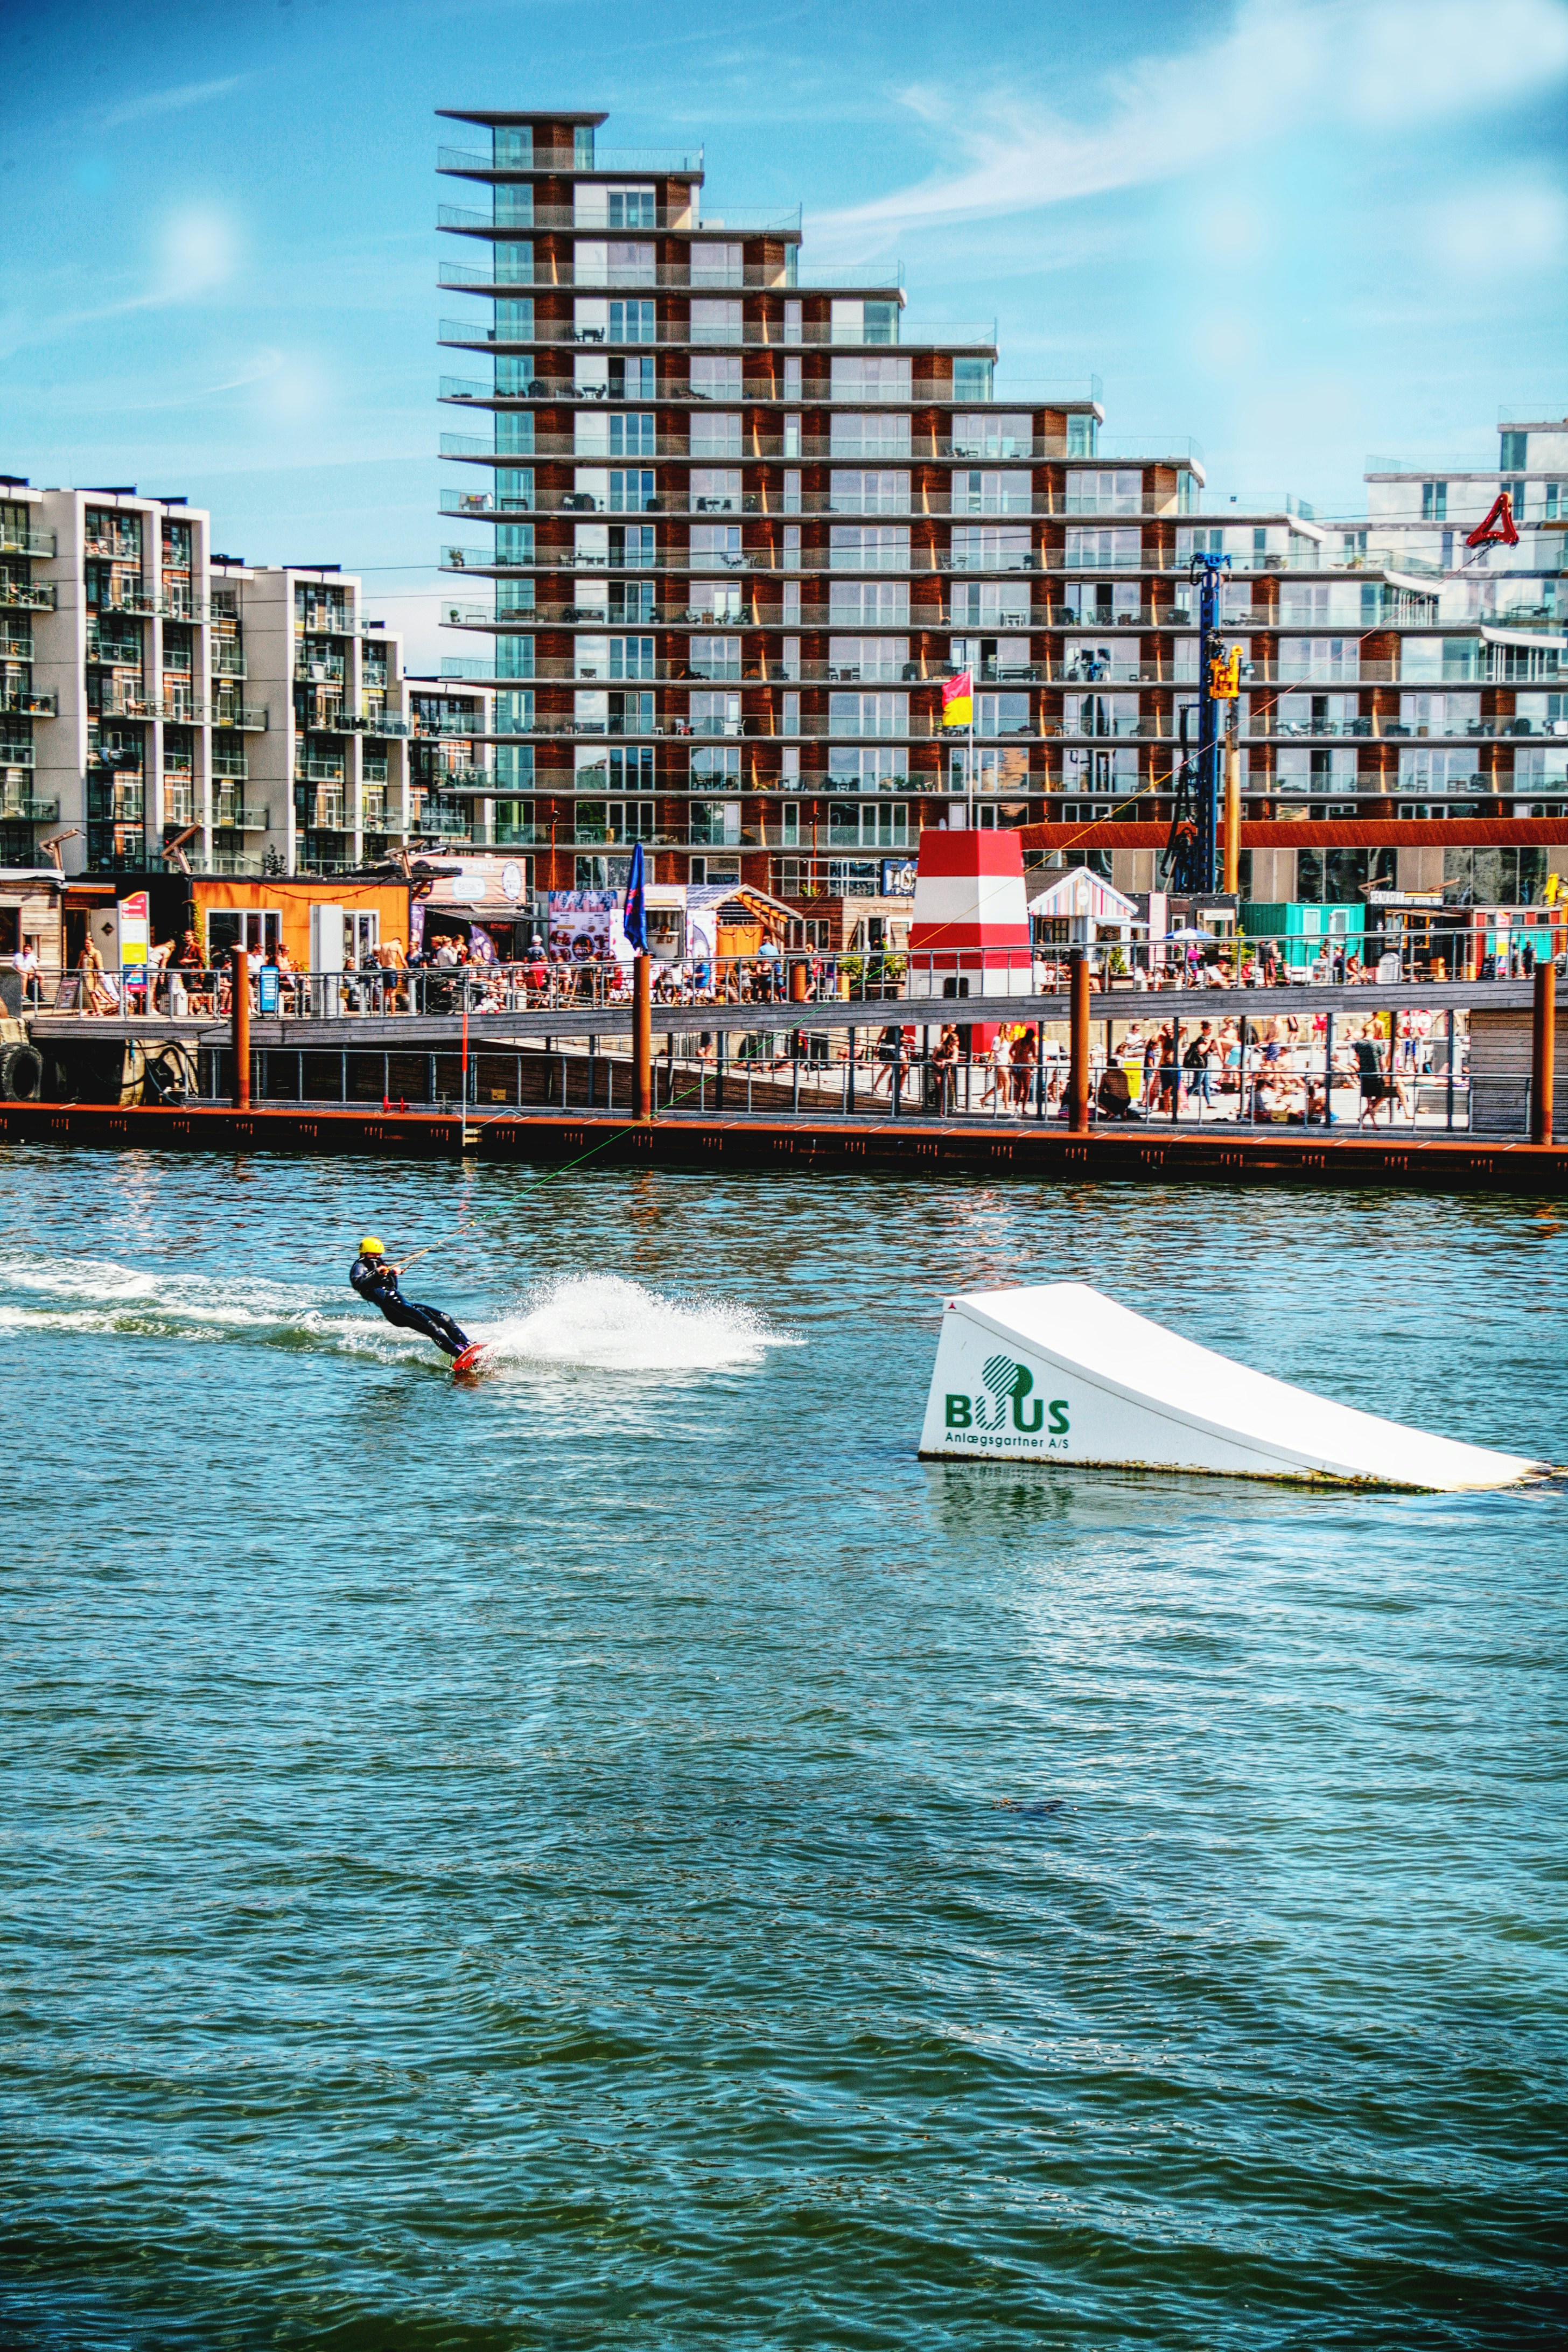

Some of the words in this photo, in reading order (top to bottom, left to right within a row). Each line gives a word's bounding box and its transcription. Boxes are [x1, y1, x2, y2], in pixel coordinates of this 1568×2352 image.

[945, 1394, 1070, 1434] BUUS
[945, 1432, 1044, 1447] Anlægsgartner
[1048, 1438, 1069, 1448] A/S
